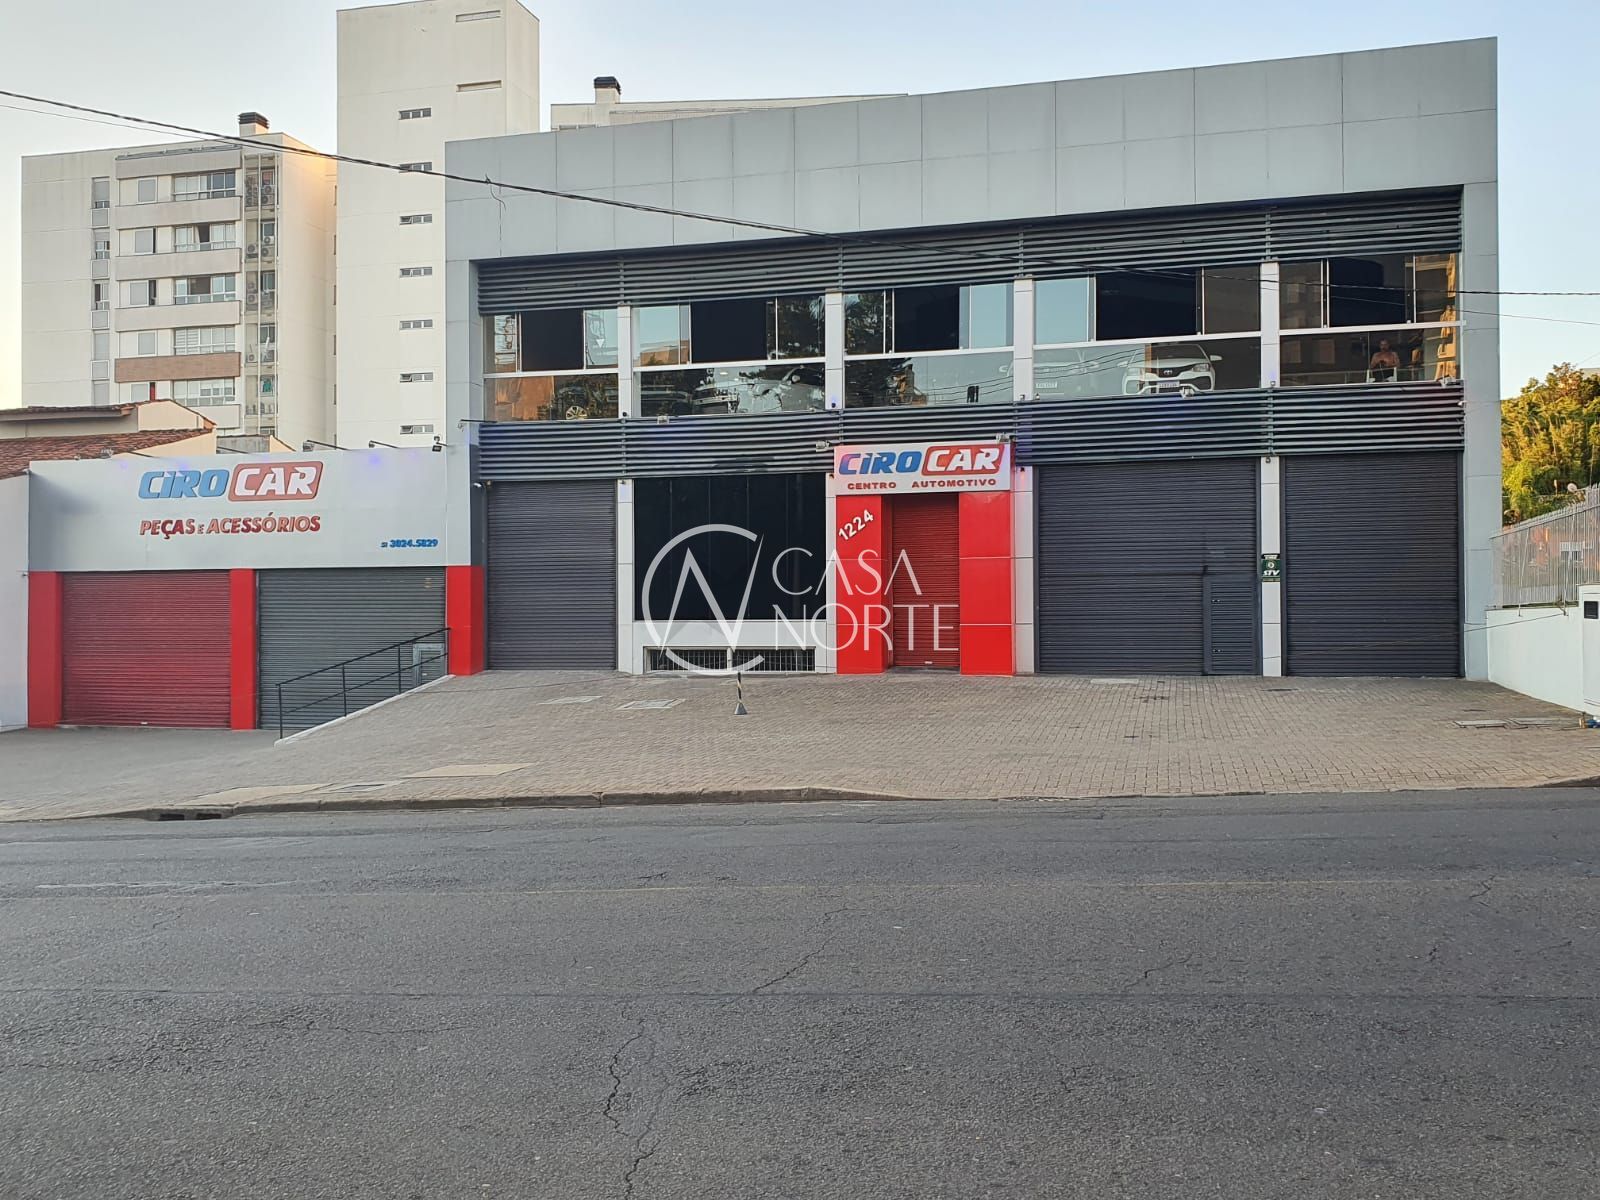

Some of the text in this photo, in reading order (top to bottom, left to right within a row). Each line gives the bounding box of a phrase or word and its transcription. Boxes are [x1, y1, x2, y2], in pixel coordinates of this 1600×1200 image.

[926, 448, 999, 472] CAR
[235, 466, 314, 496] CAR
[848, 478, 997, 490] CENTRO AUTOMOTIVO
[140, 519, 195, 540] PEÇAS
[206, 512, 321, 534] ACESSÓRIOS
[838, 509, 875, 541] 1224
